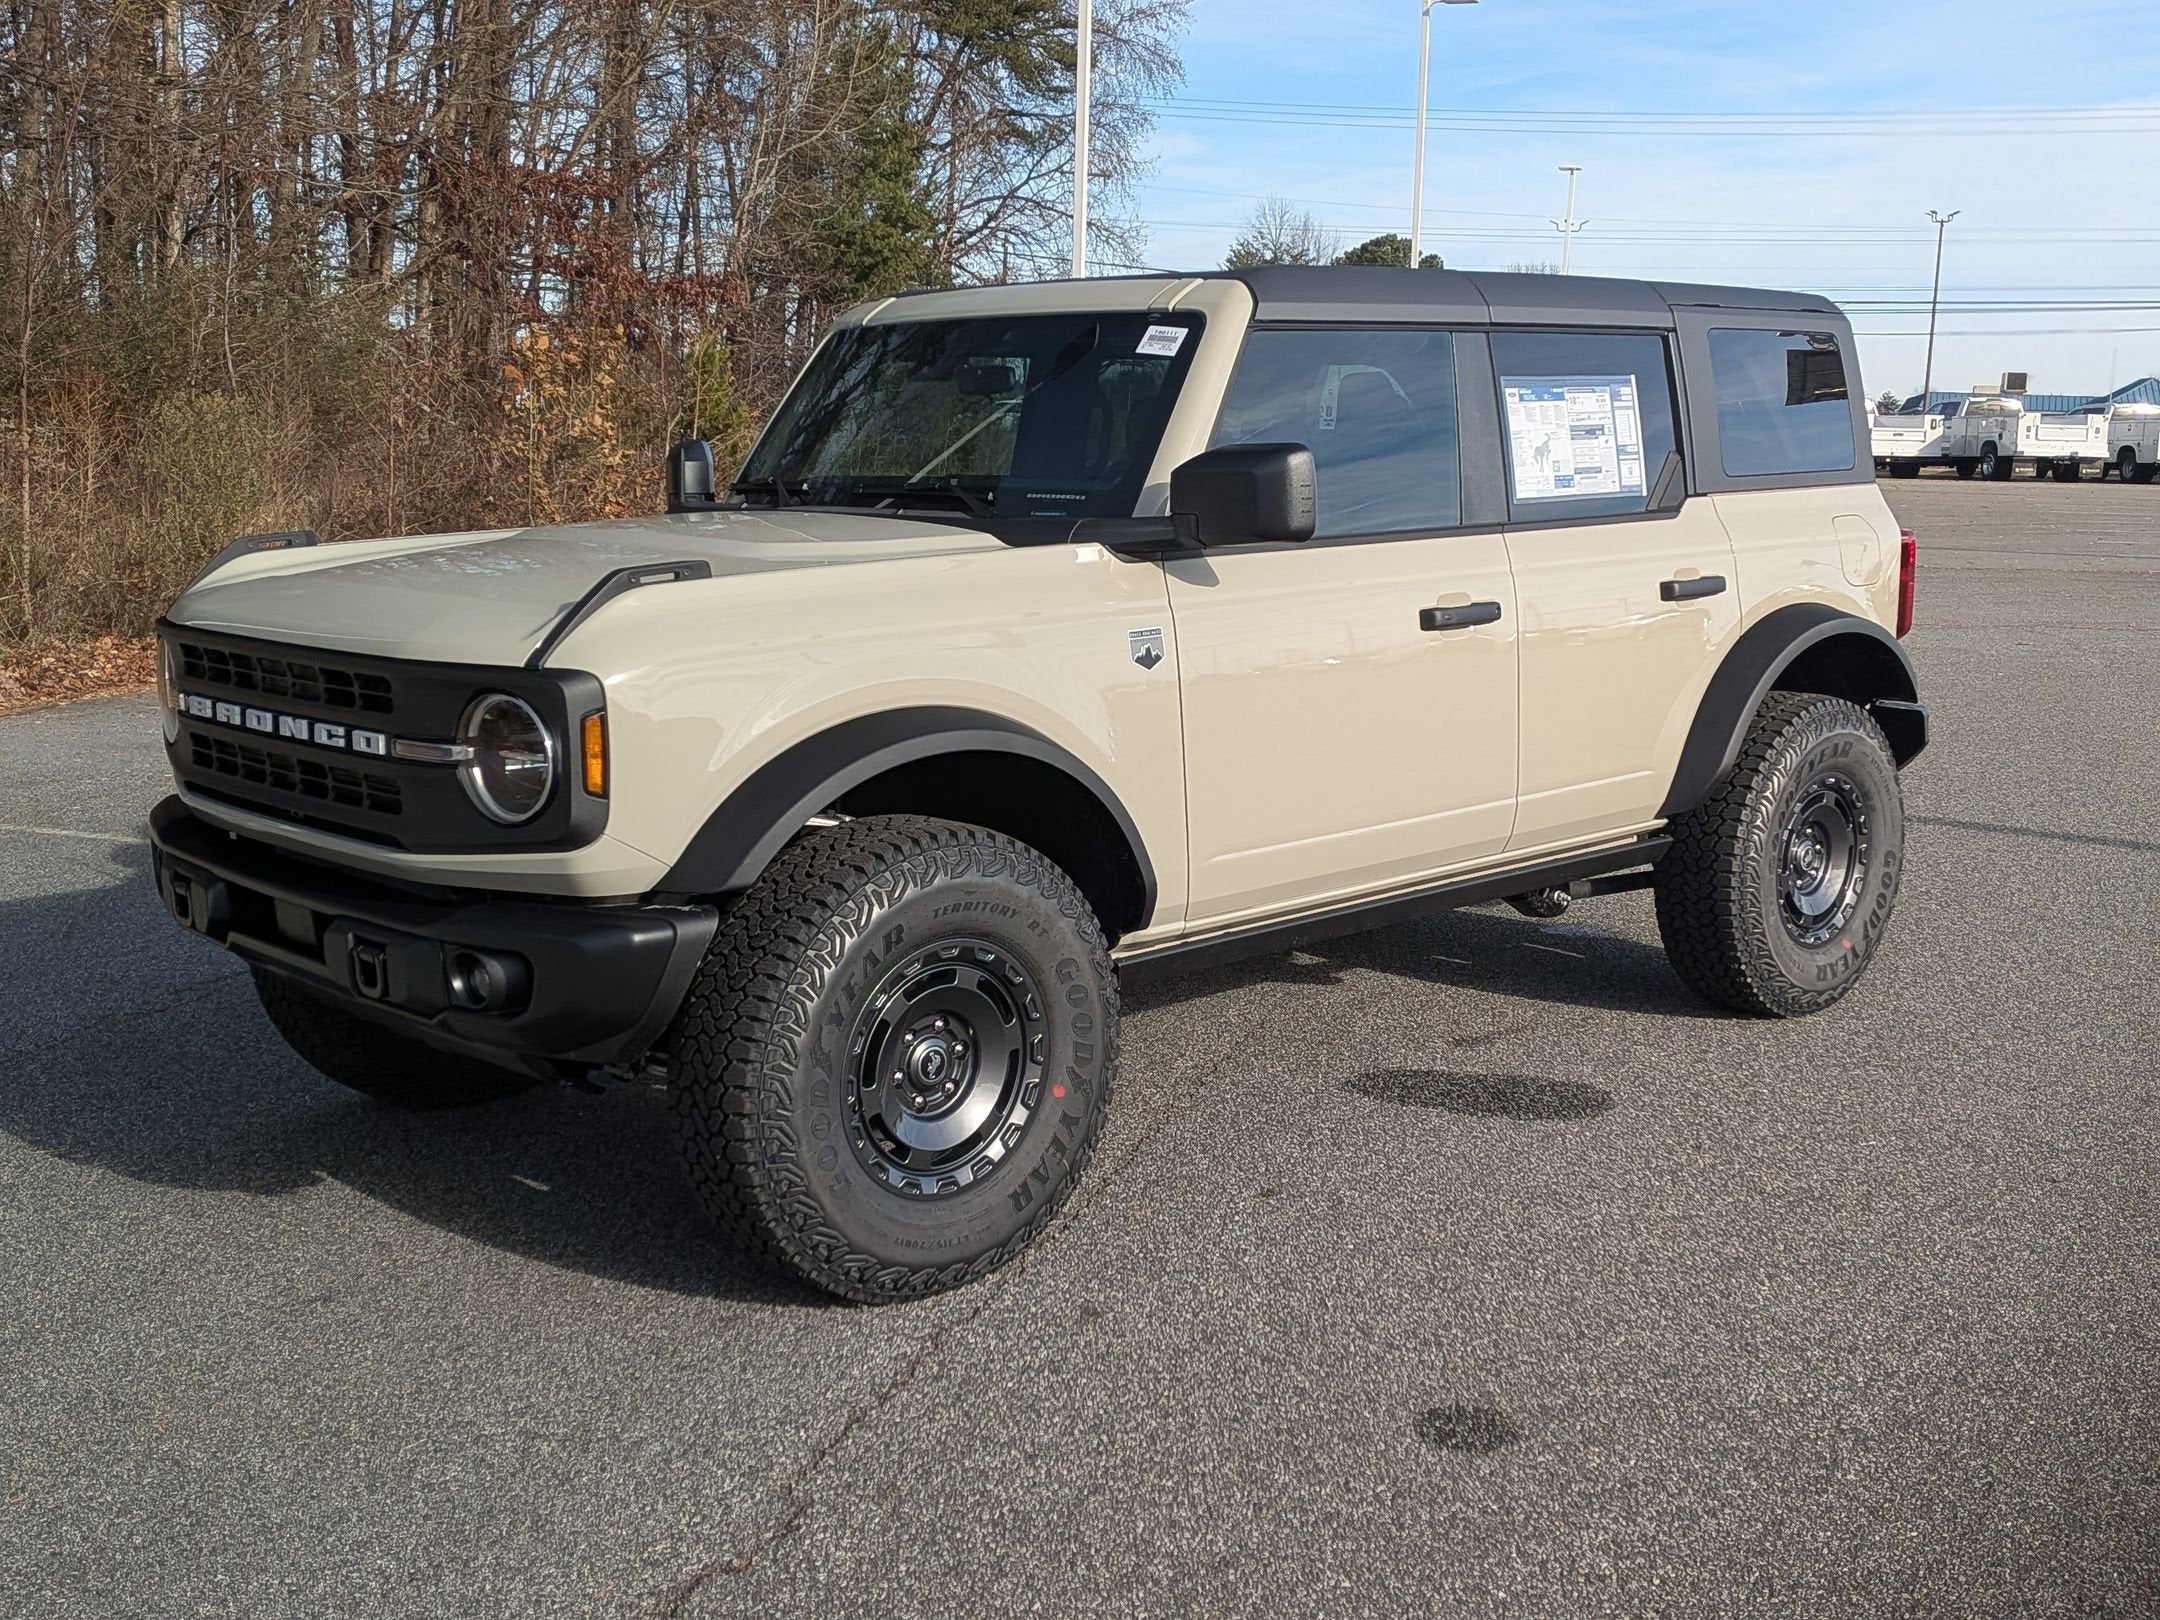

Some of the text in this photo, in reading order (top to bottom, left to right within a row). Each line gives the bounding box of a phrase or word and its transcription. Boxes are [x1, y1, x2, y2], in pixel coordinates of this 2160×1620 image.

[1026, 493, 1087, 501] BRONCO
[188, 695, 386, 756] BRONCO
[932, 901, 1050, 940] TERRITORY RT
